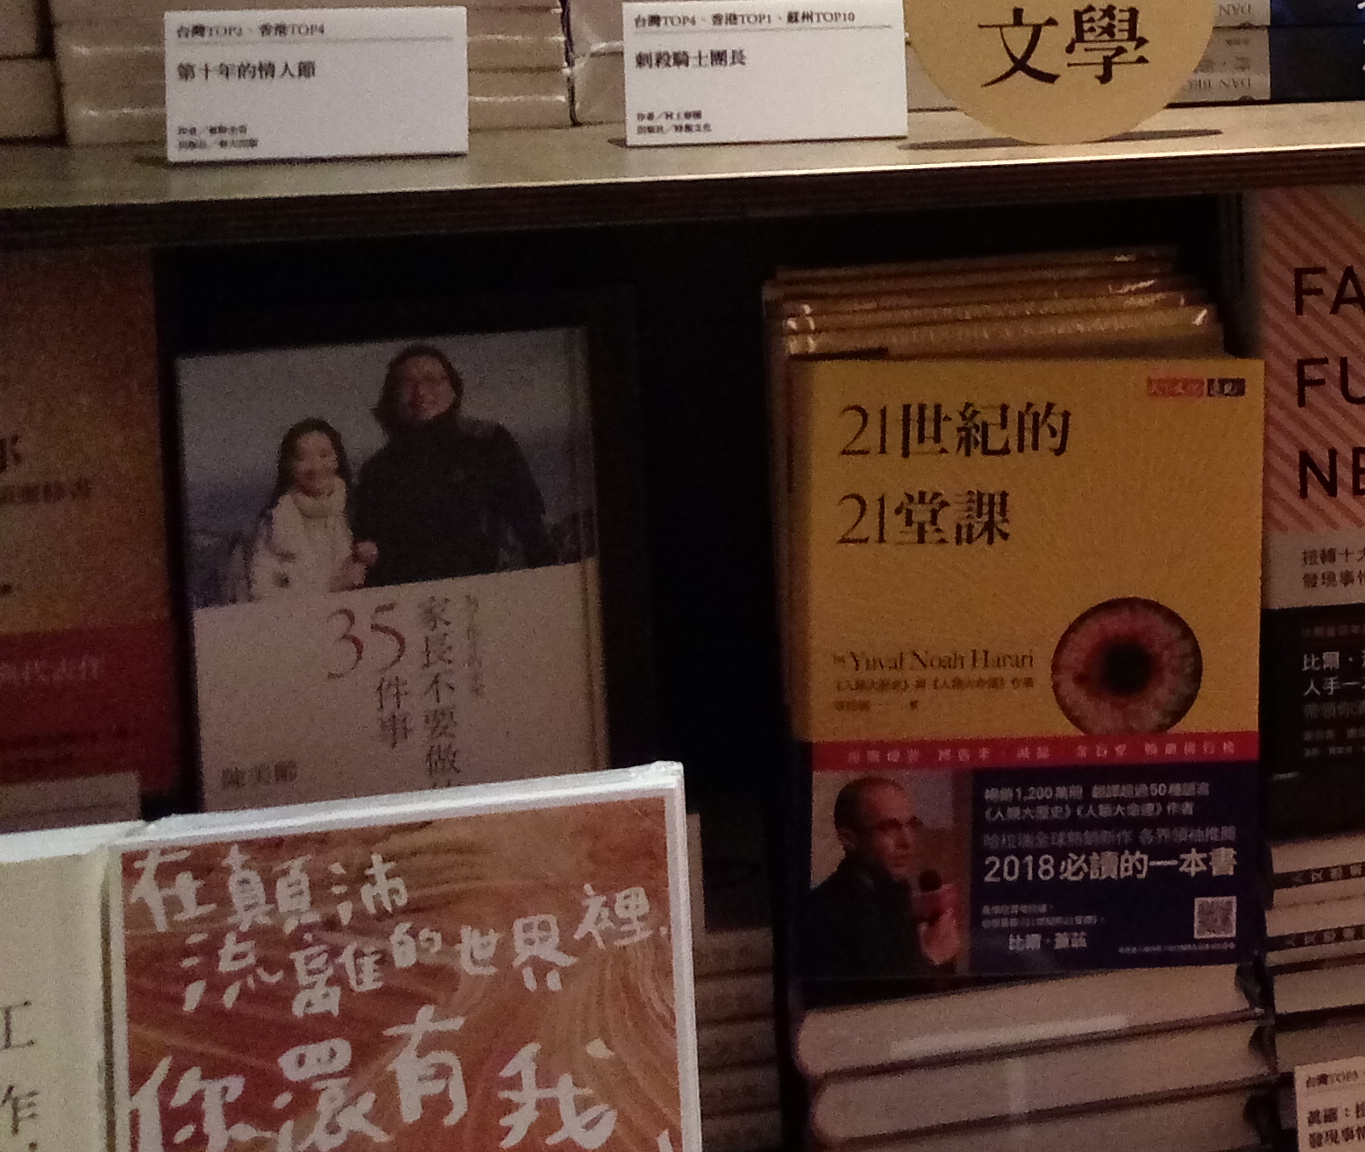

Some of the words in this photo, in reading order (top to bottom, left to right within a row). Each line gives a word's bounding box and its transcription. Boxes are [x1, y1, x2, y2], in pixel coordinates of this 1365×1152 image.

[177, 60, 316, 81] 第十年的情人節
[635, 49, 746, 69] 刺殺騎士團長
[977, 4, 1150, 87] 文學
[838, 401, 1072, 459] 21世紀的
[837, 490, 1011, 546] 21堂課
[328, 602, 408, 680] 35
[376, 674, 412, 749] 件事
[984, 847, 1237, 883] 2018必讀的一本書
